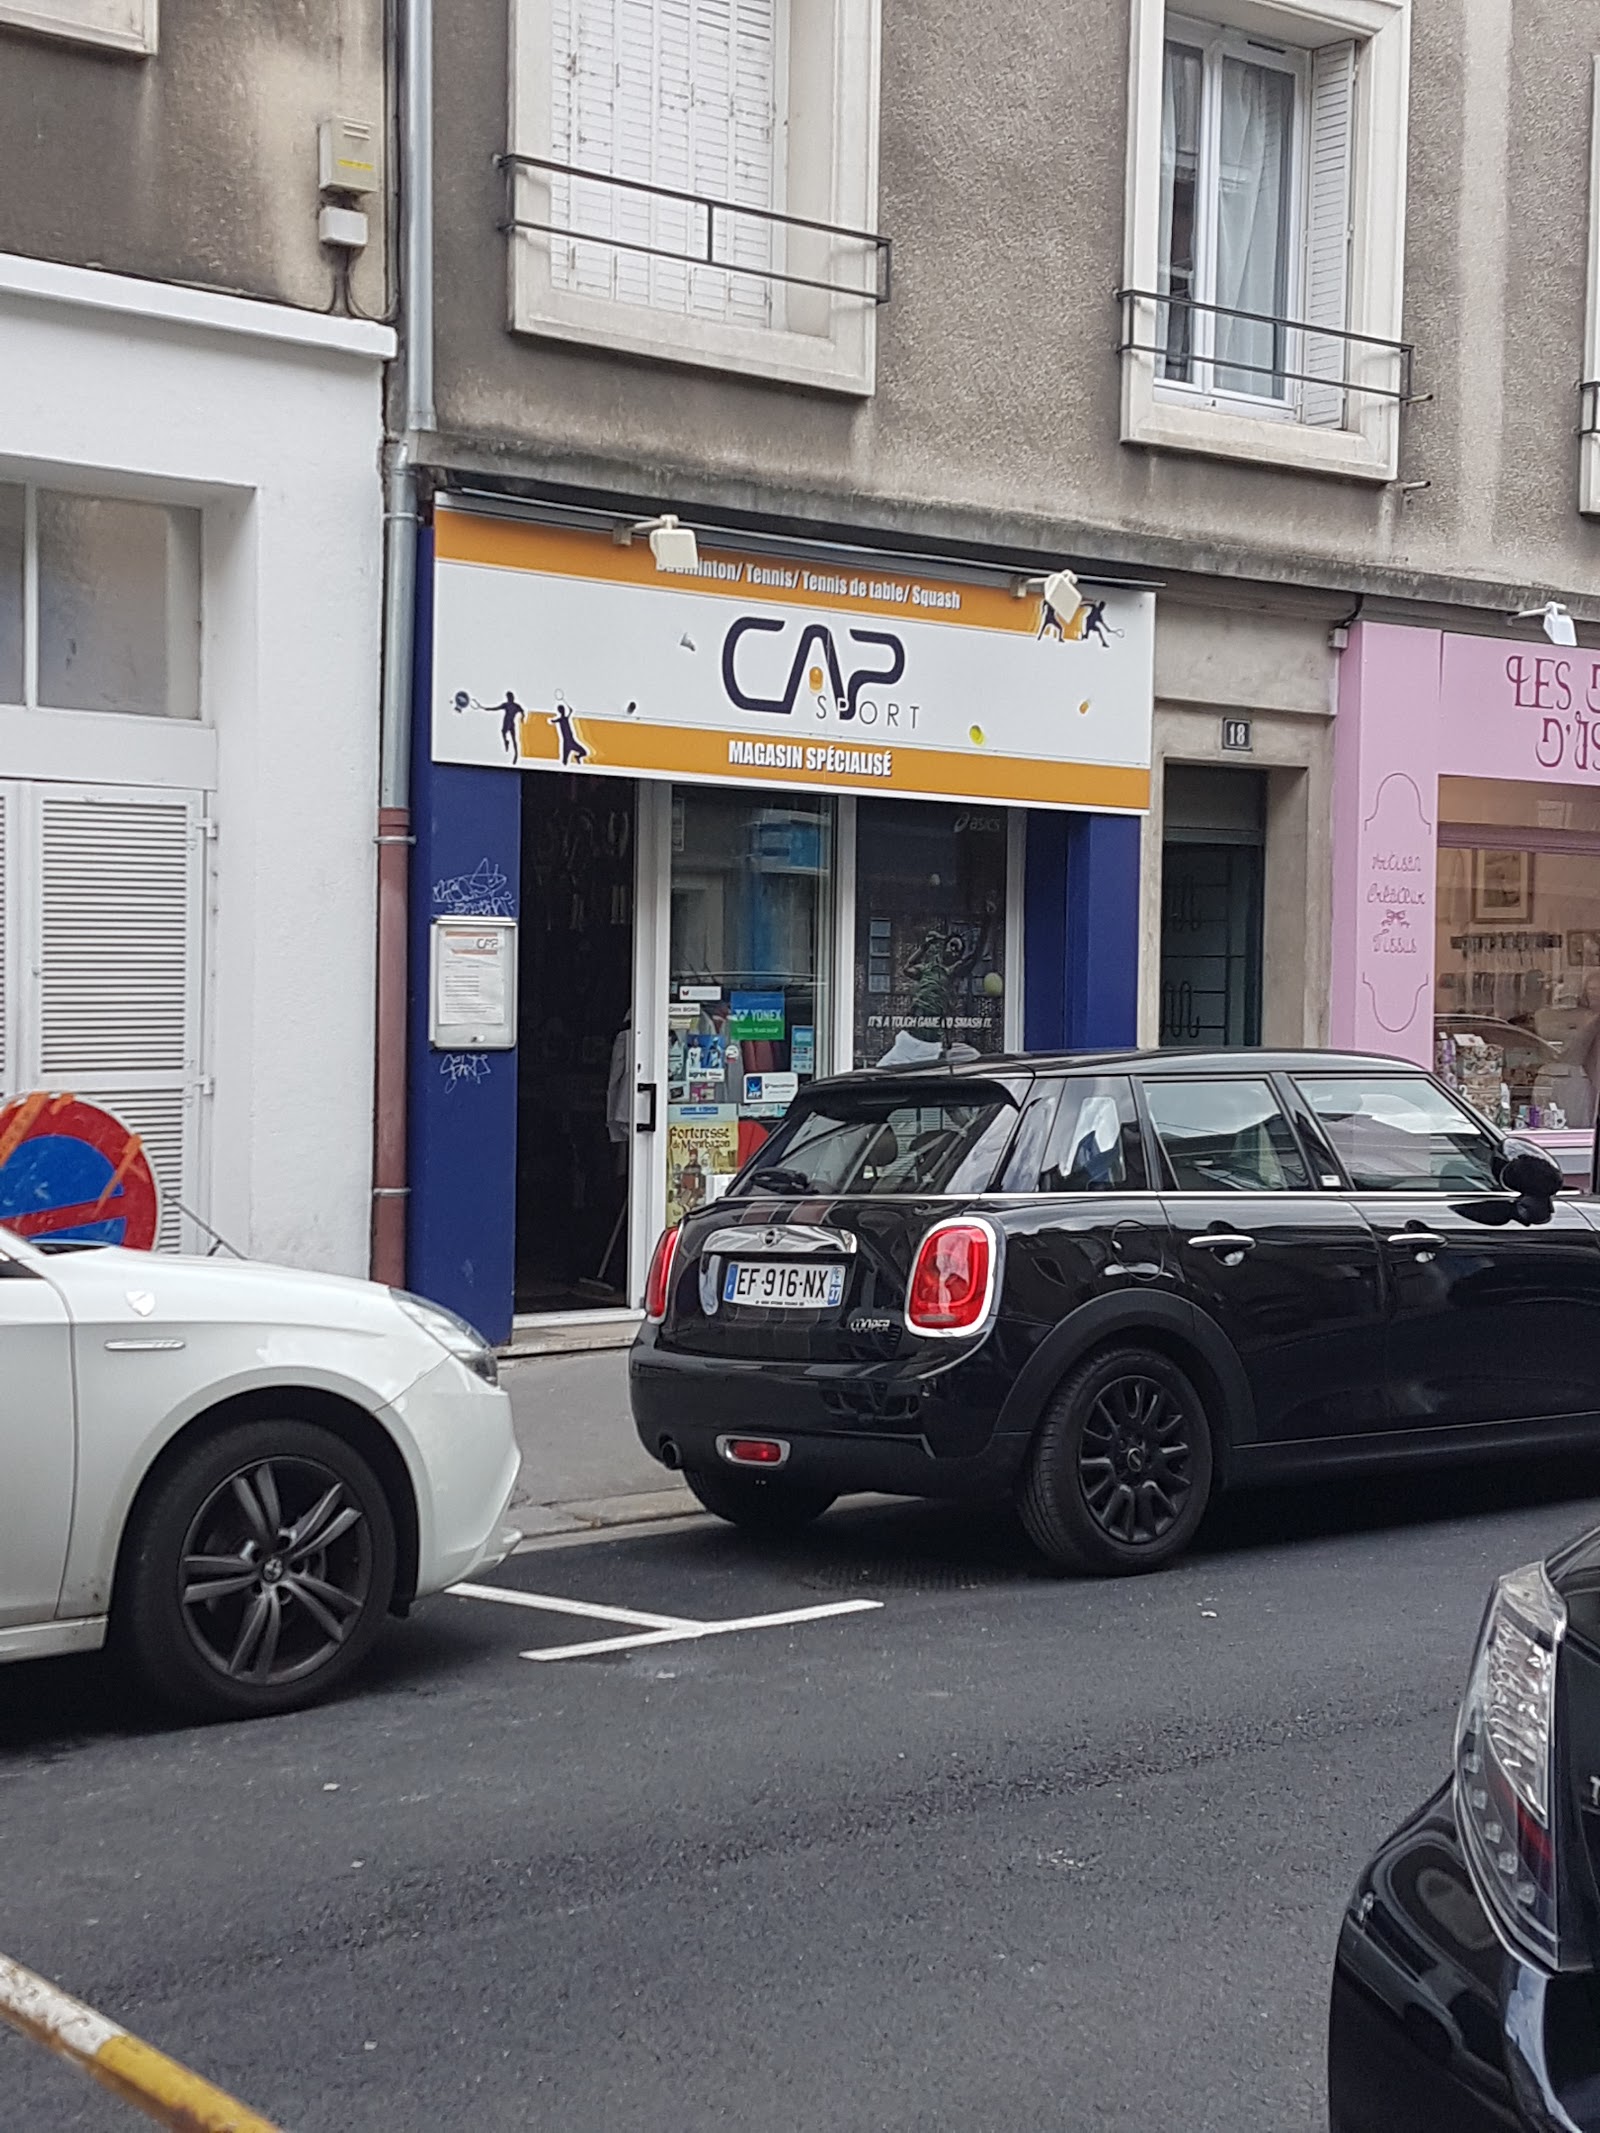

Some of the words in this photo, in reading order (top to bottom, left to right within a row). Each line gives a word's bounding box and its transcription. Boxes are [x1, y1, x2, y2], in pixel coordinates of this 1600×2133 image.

[657, 556, 743, 582] inton/
[746, 563, 800, 589] Tennis/
[802, 571, 848, 595] Tennis
[850, 577, 868, 597] de
[869, 580, 911, 603] table/
[912, 585, 962, 610] Squash
[722, 616, 905, 721] CAP
[1506, 655, 1572, 710] LES
[815, 695, 920, 729] SPORT
[1229, 723, 1246, 745] 18
[728, 740, 803, 769] MAGASIN
[805, 745, 893, 776] SPÉCIALISÉ
[1373, 928, 1417, 953] Tissus
[750, 1009, 782, 1022] YONEX
[891, 1016, 917, 1028] TOUGH
[917, 1016, 940, 1028] GAME
[953, 1017, 981, 1029] SMASH
[669, 1126, 730, 1140] Forteresse
